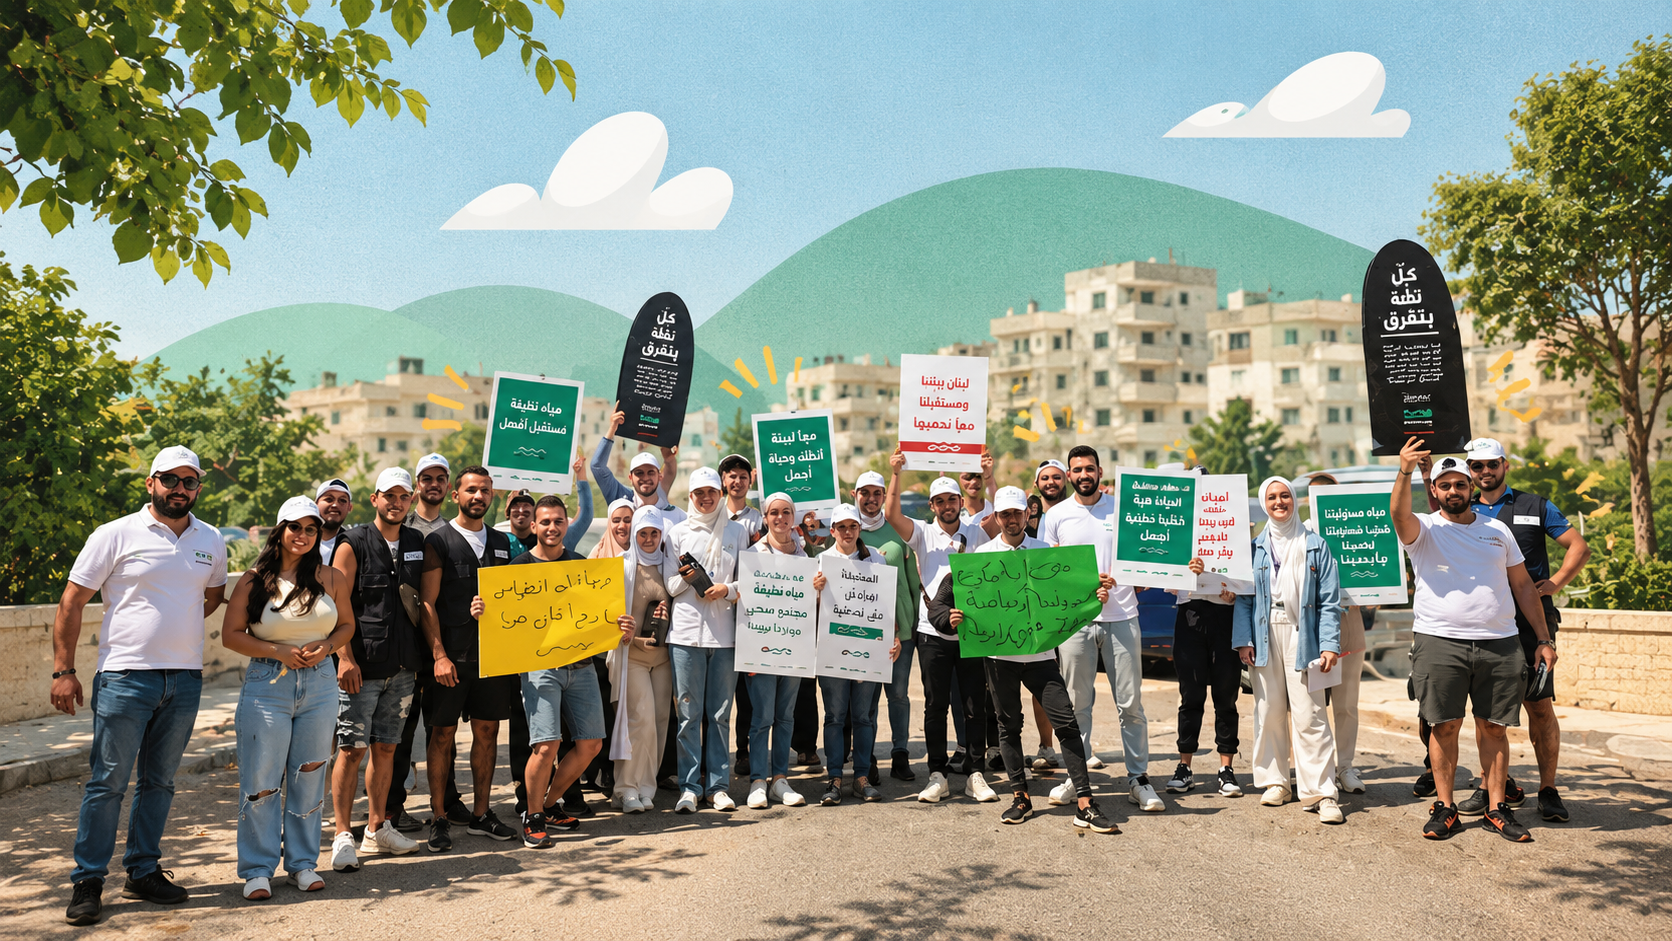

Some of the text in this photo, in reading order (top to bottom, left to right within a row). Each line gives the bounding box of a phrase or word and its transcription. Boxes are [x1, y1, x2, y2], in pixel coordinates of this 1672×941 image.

[946, 377, 970, 392] لبنان
[540, 402, 562, 417] مياه
[784, 464, 812, 482] أجمل
